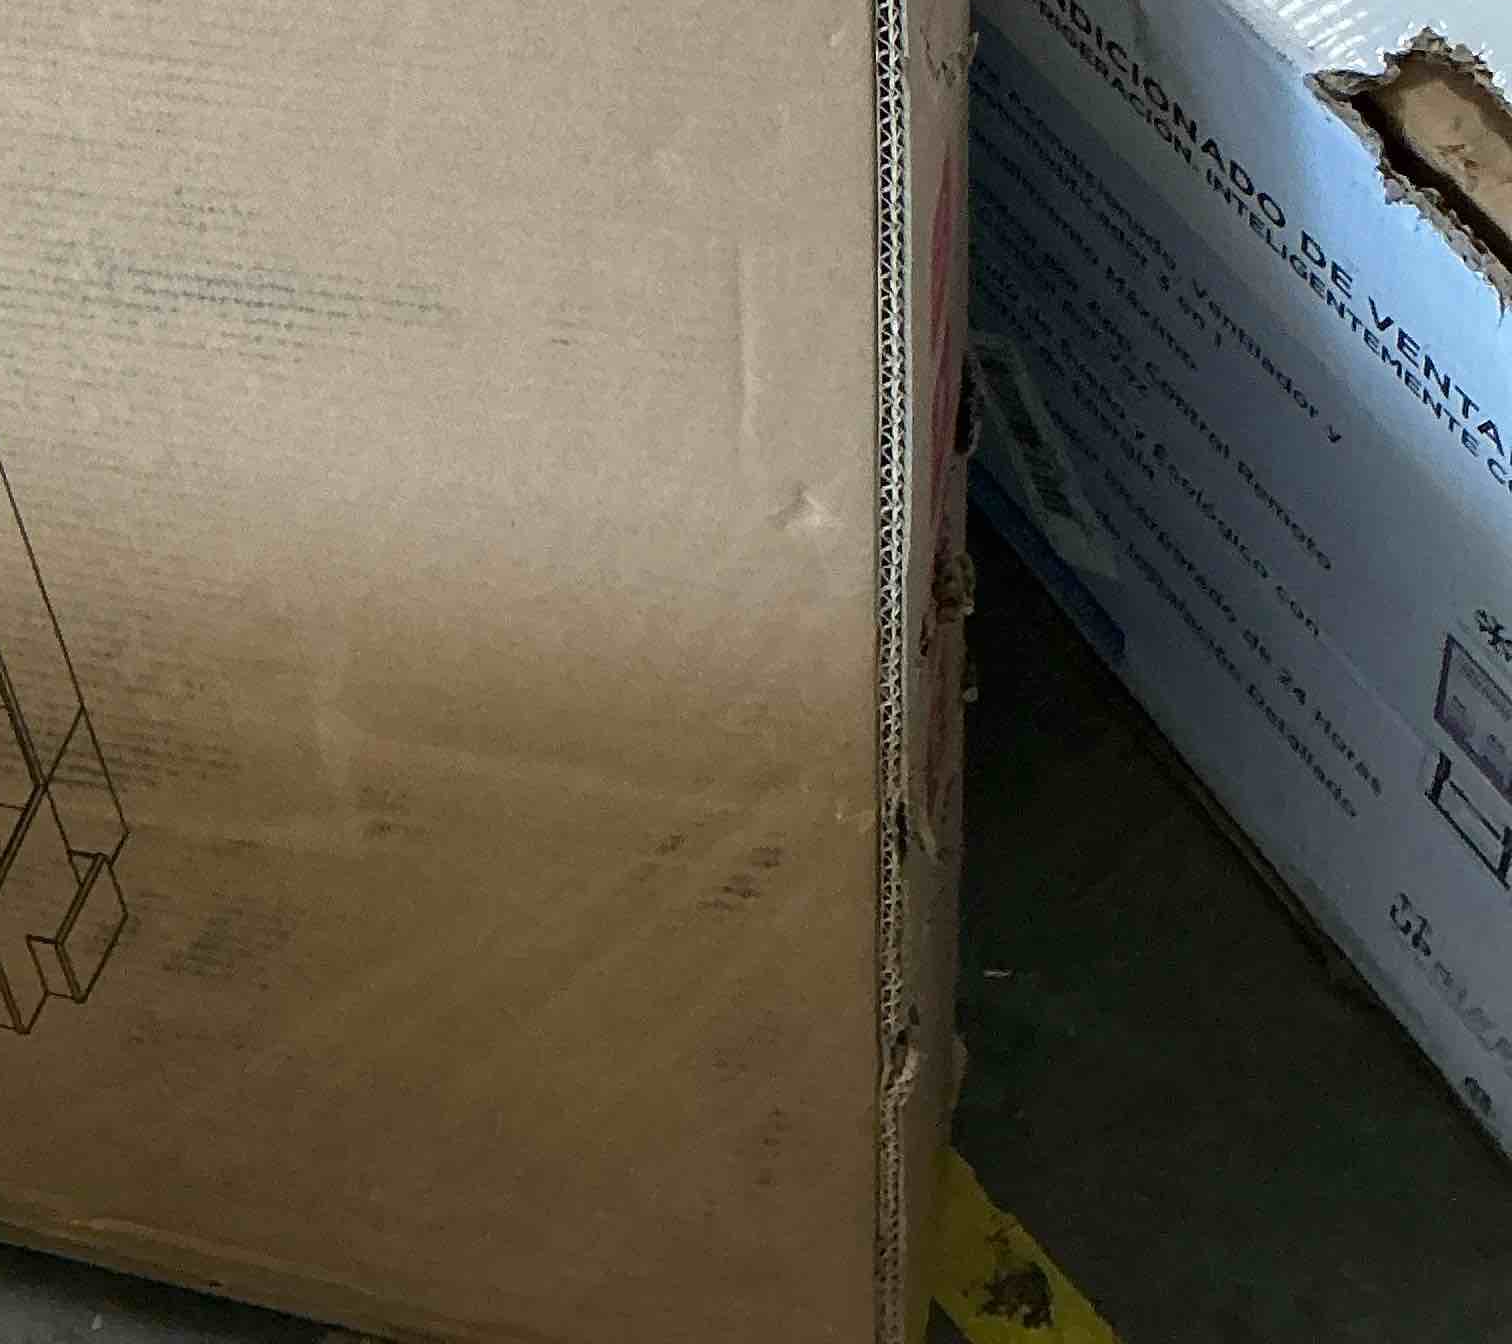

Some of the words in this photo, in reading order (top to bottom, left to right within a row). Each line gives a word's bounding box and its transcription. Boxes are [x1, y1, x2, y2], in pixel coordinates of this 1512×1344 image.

[1204, 167, 1479, 457] INTELIGENTEMENTE
[1301, 230, 1353, 299] DE
[1368, 296, 1512, 465] VENTA
[1276, 584, 1320, 637] con
[1314, 709, 1382, 797] Horas
